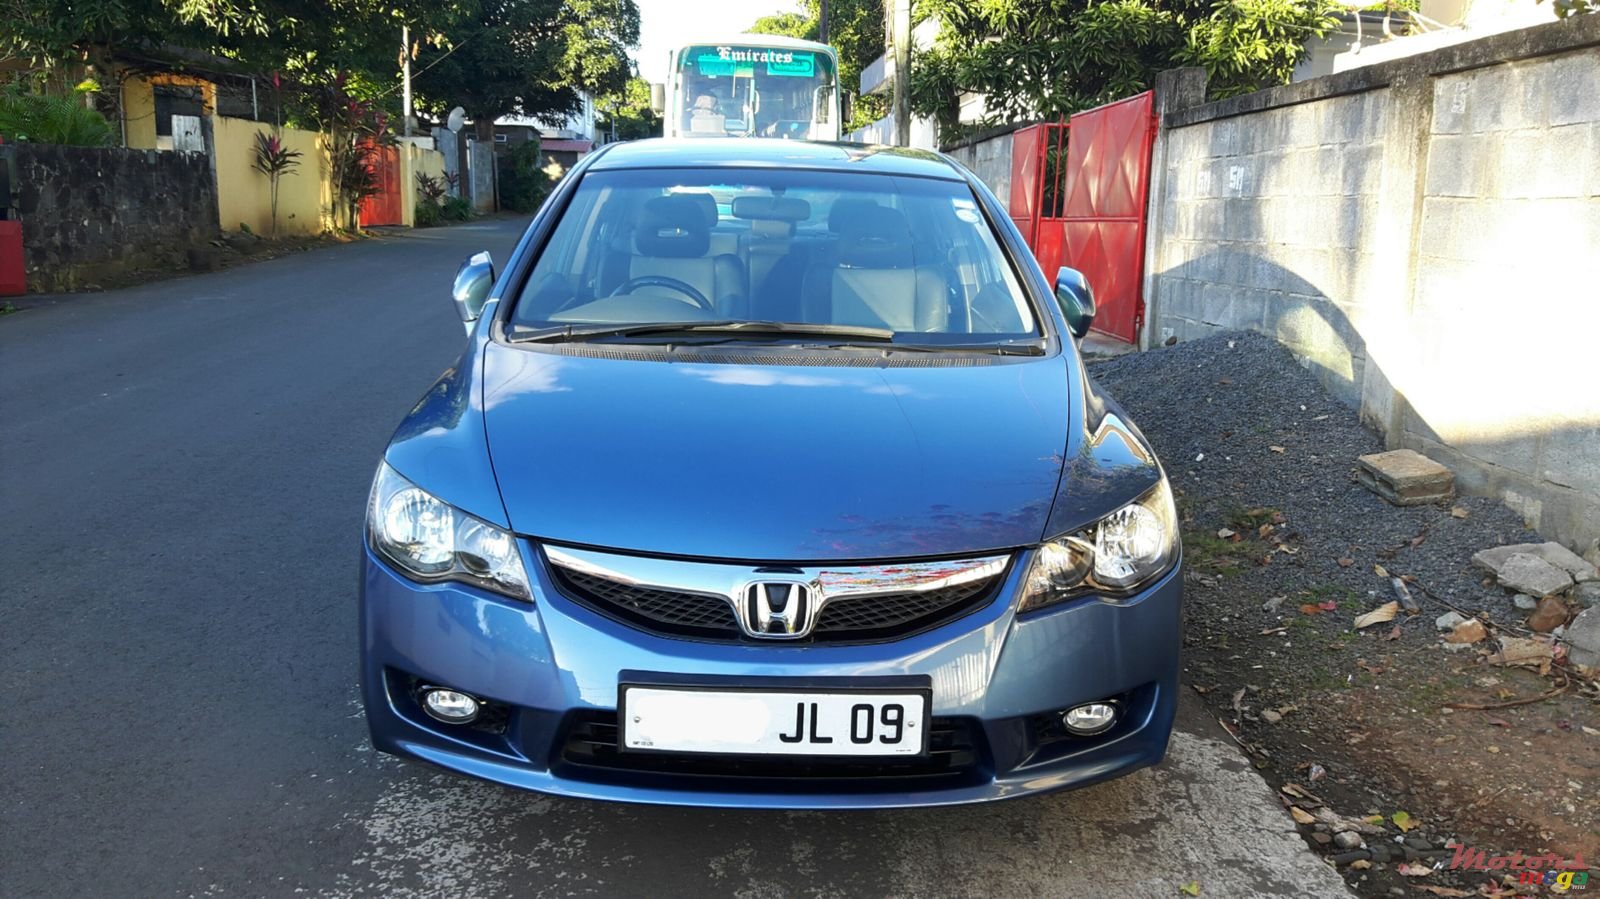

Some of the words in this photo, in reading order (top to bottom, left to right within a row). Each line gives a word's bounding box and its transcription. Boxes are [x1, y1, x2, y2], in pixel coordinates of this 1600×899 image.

[716, 46, 793, 64] Emirates
[779, 702, 833, 744] JL
[850, 703, 904, 744] 09
